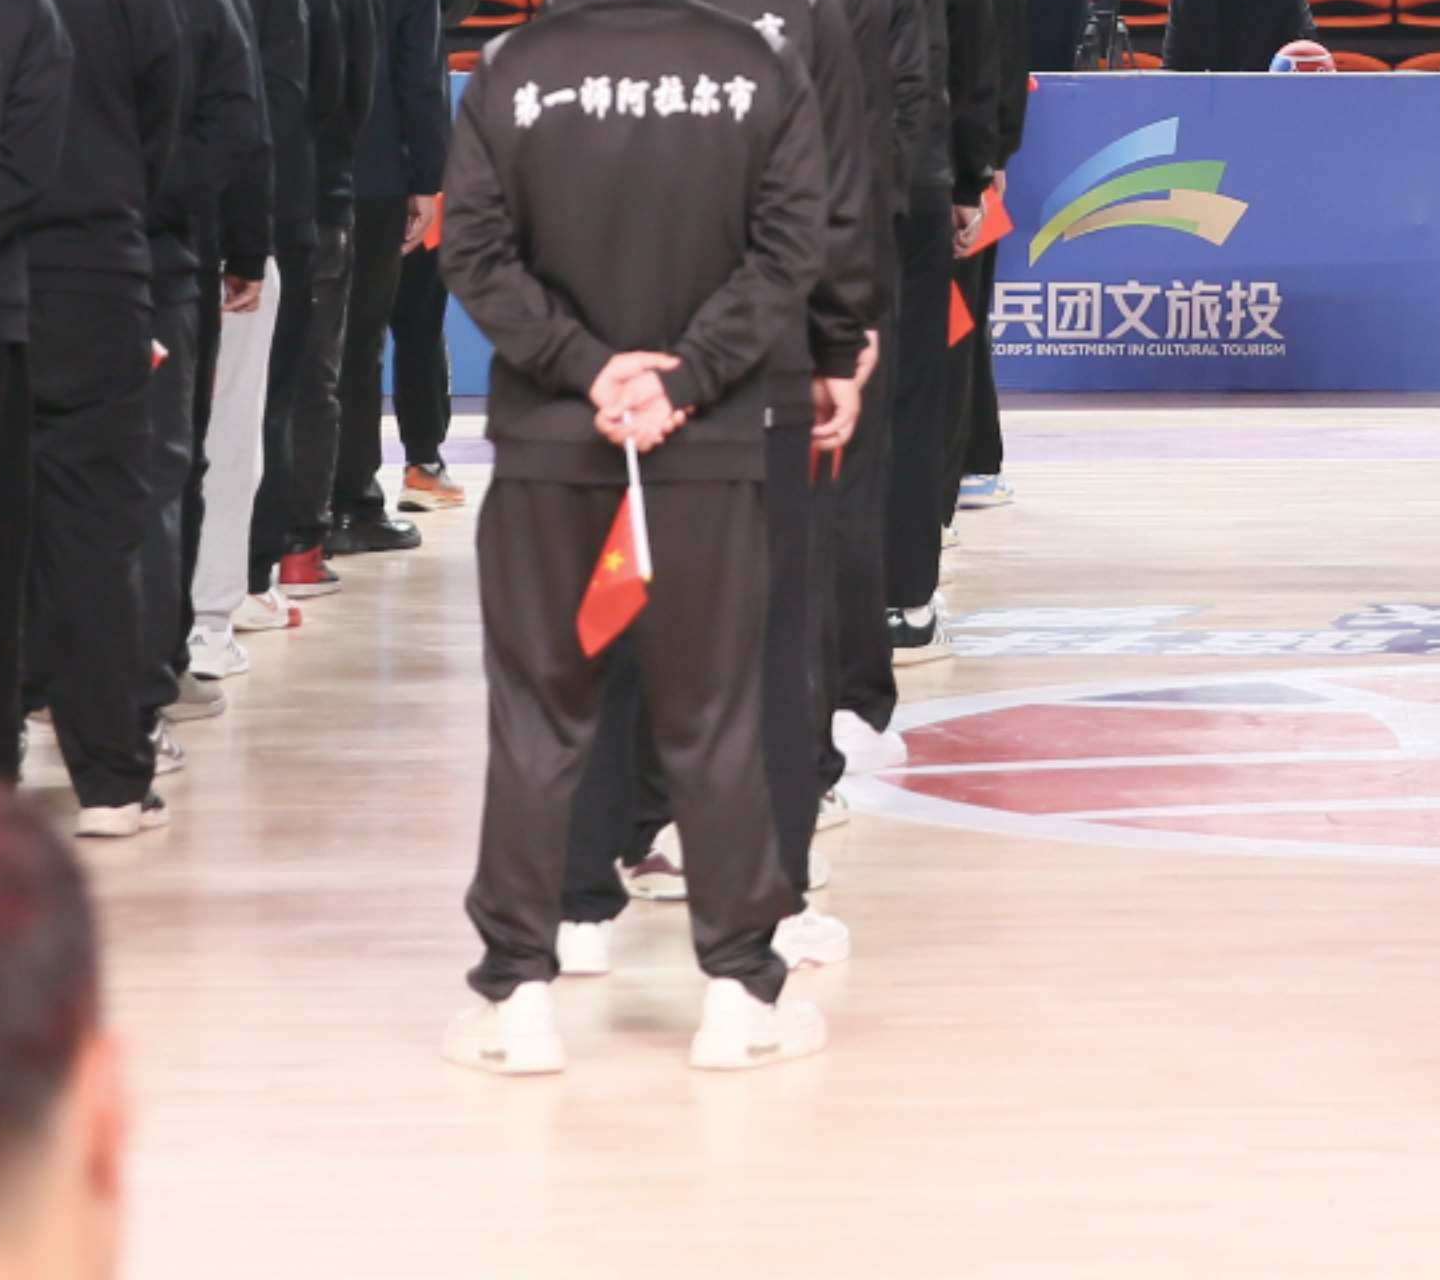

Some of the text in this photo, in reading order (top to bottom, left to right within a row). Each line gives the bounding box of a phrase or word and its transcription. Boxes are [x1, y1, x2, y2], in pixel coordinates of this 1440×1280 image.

[513, 74, 758, 128] 第一师阿拉尔市
[989, 280, 1285, 340] 兵团文旅投
[1037, 343, 1127, 357] INVESTMENT
[1128, 343, 1144, 357] IN
[1147, 343, 1218, 357] CULTURAL
[1222, 343, 1287, 357] TOURISM
